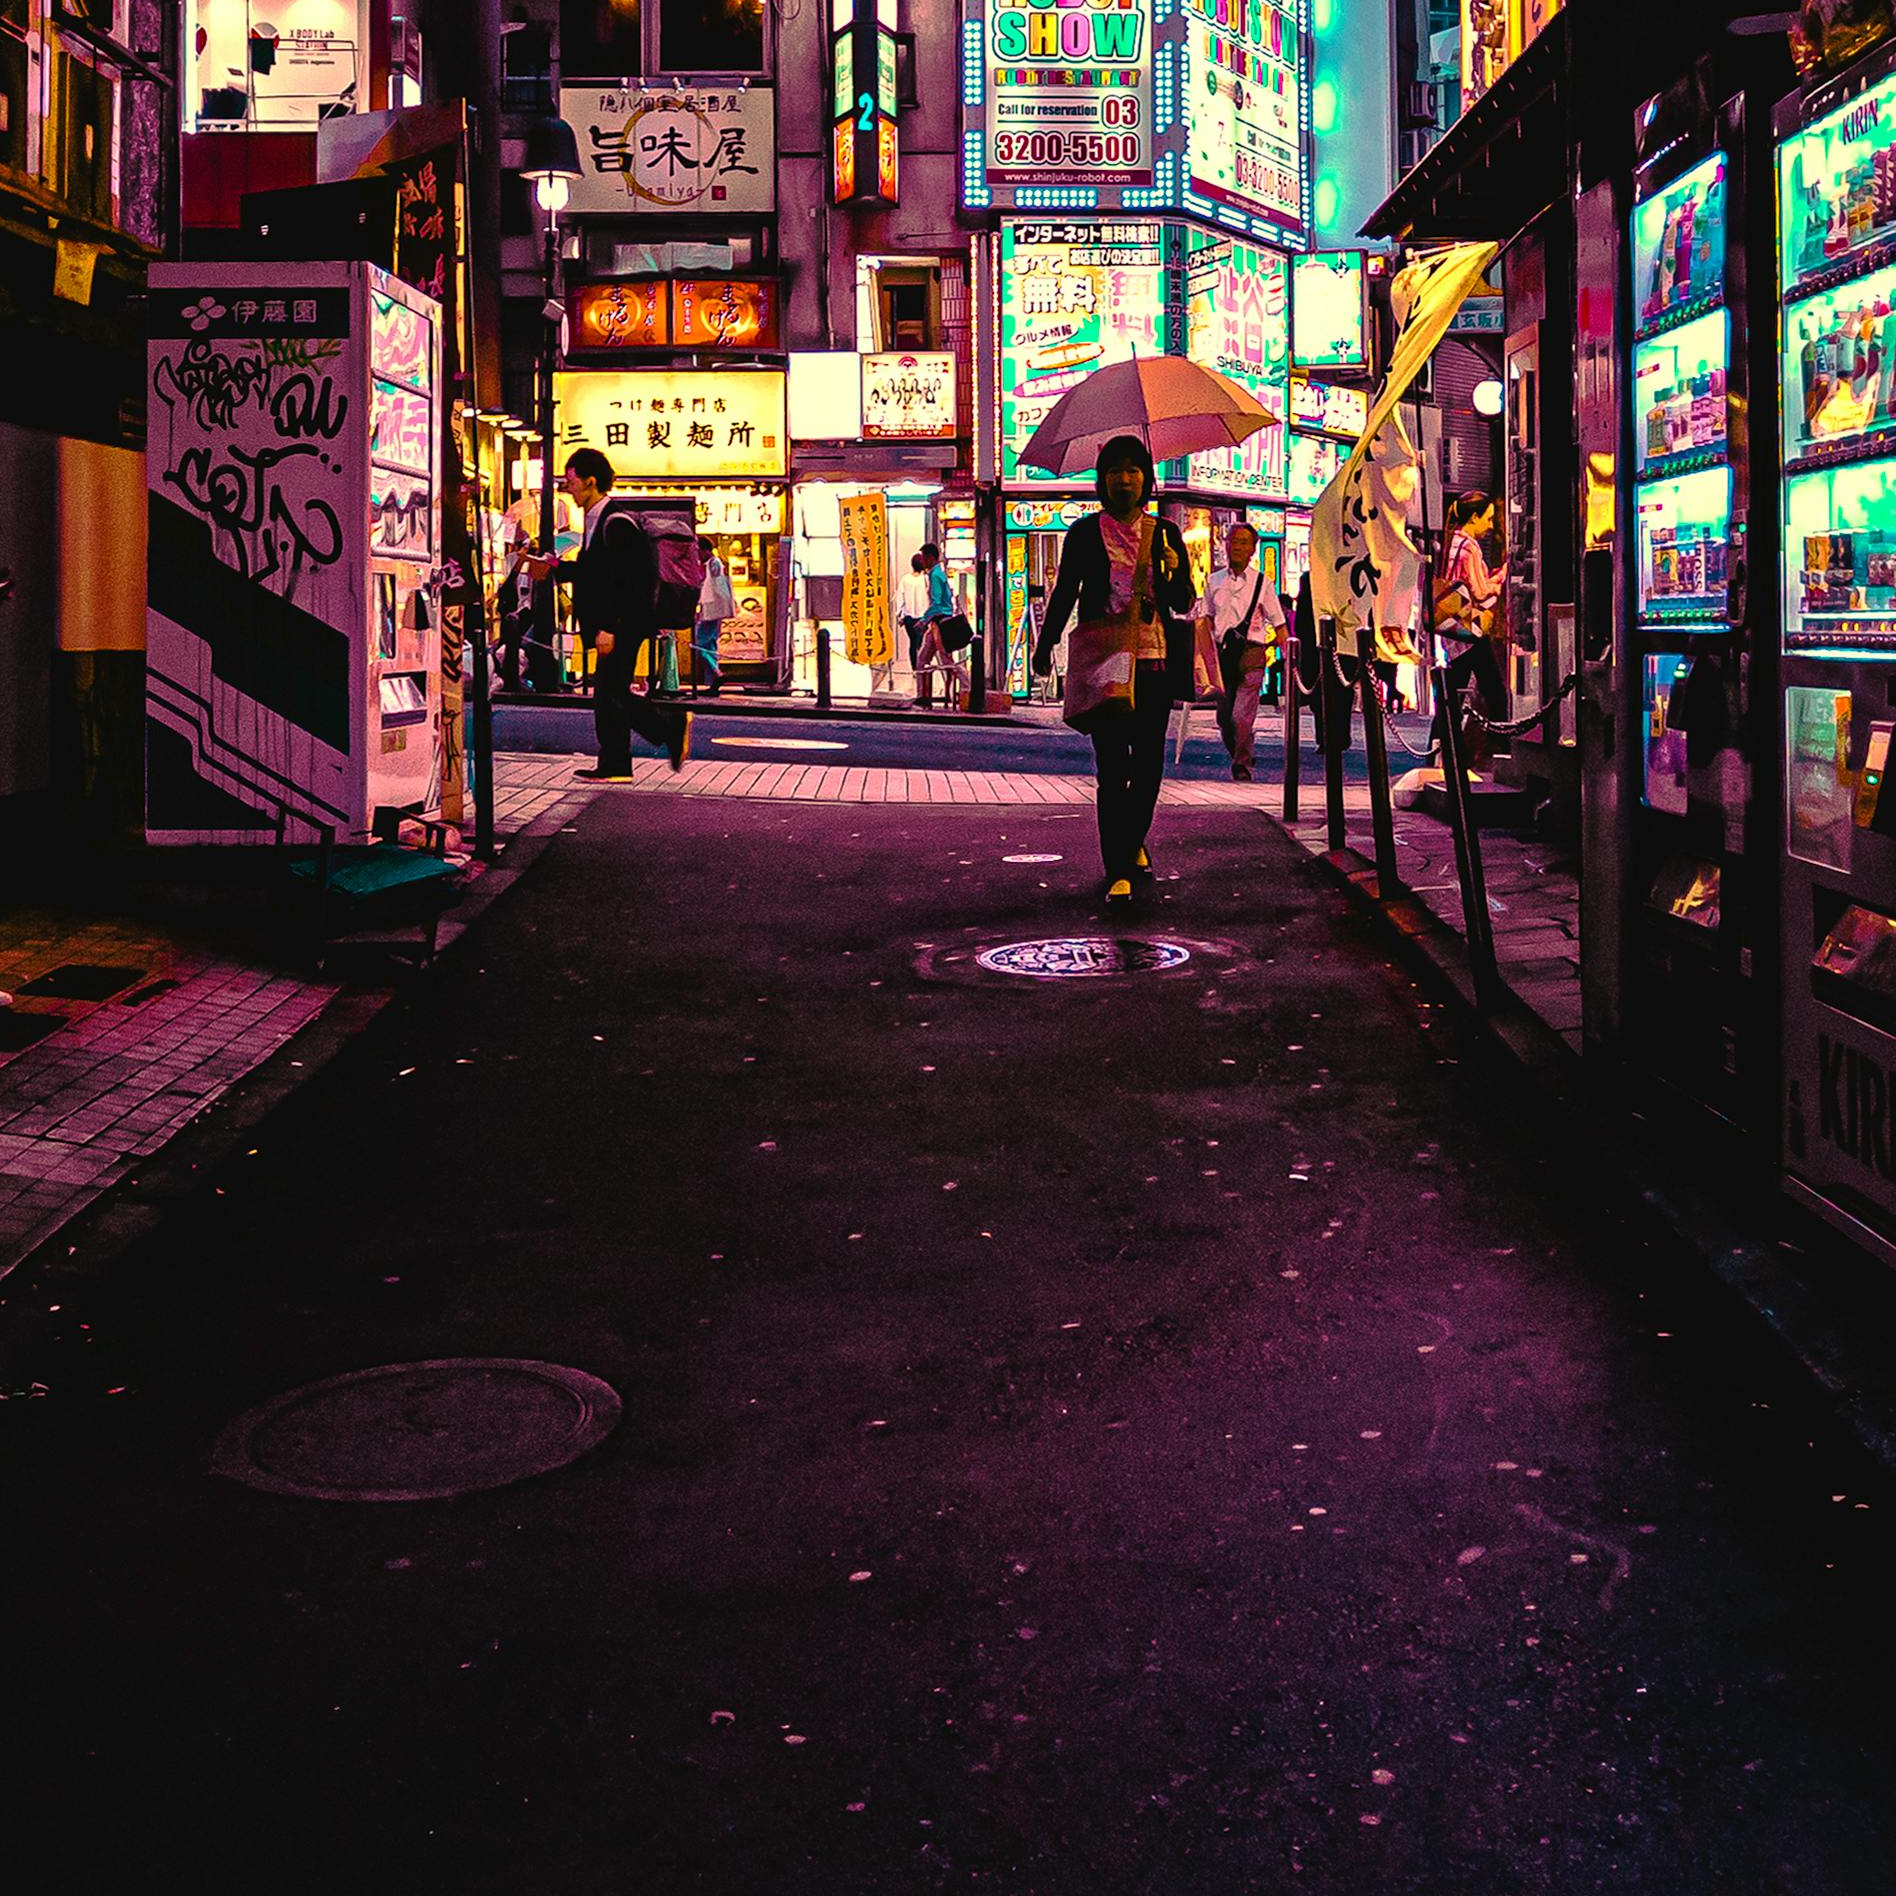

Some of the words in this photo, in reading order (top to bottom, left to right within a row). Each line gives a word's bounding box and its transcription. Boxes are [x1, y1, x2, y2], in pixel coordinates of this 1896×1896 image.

[997, 11, 1139, 58] SHOW
[857, 91, 874, 132] 2
[998, 103, 1019, 116] Call
[1036, 103, 1098, 117] reservation
[1104, 98, 1137, 125] 03
[1842, 97, 1879, 146] KIRIN
[588, 124, 760, 178] 旨味屋
[997, 134, 1139, 162] 3200-5500
[1004, 171, 1132, 184] www.shinjuku-robot.com
[1021, 274, 1097, 315] 無料
[231, 299, 319, 326] 伊藤園
[1216, 354, 1264, 377] SHIBUYA
[563, 420, 755, 449] 三田製麺所
